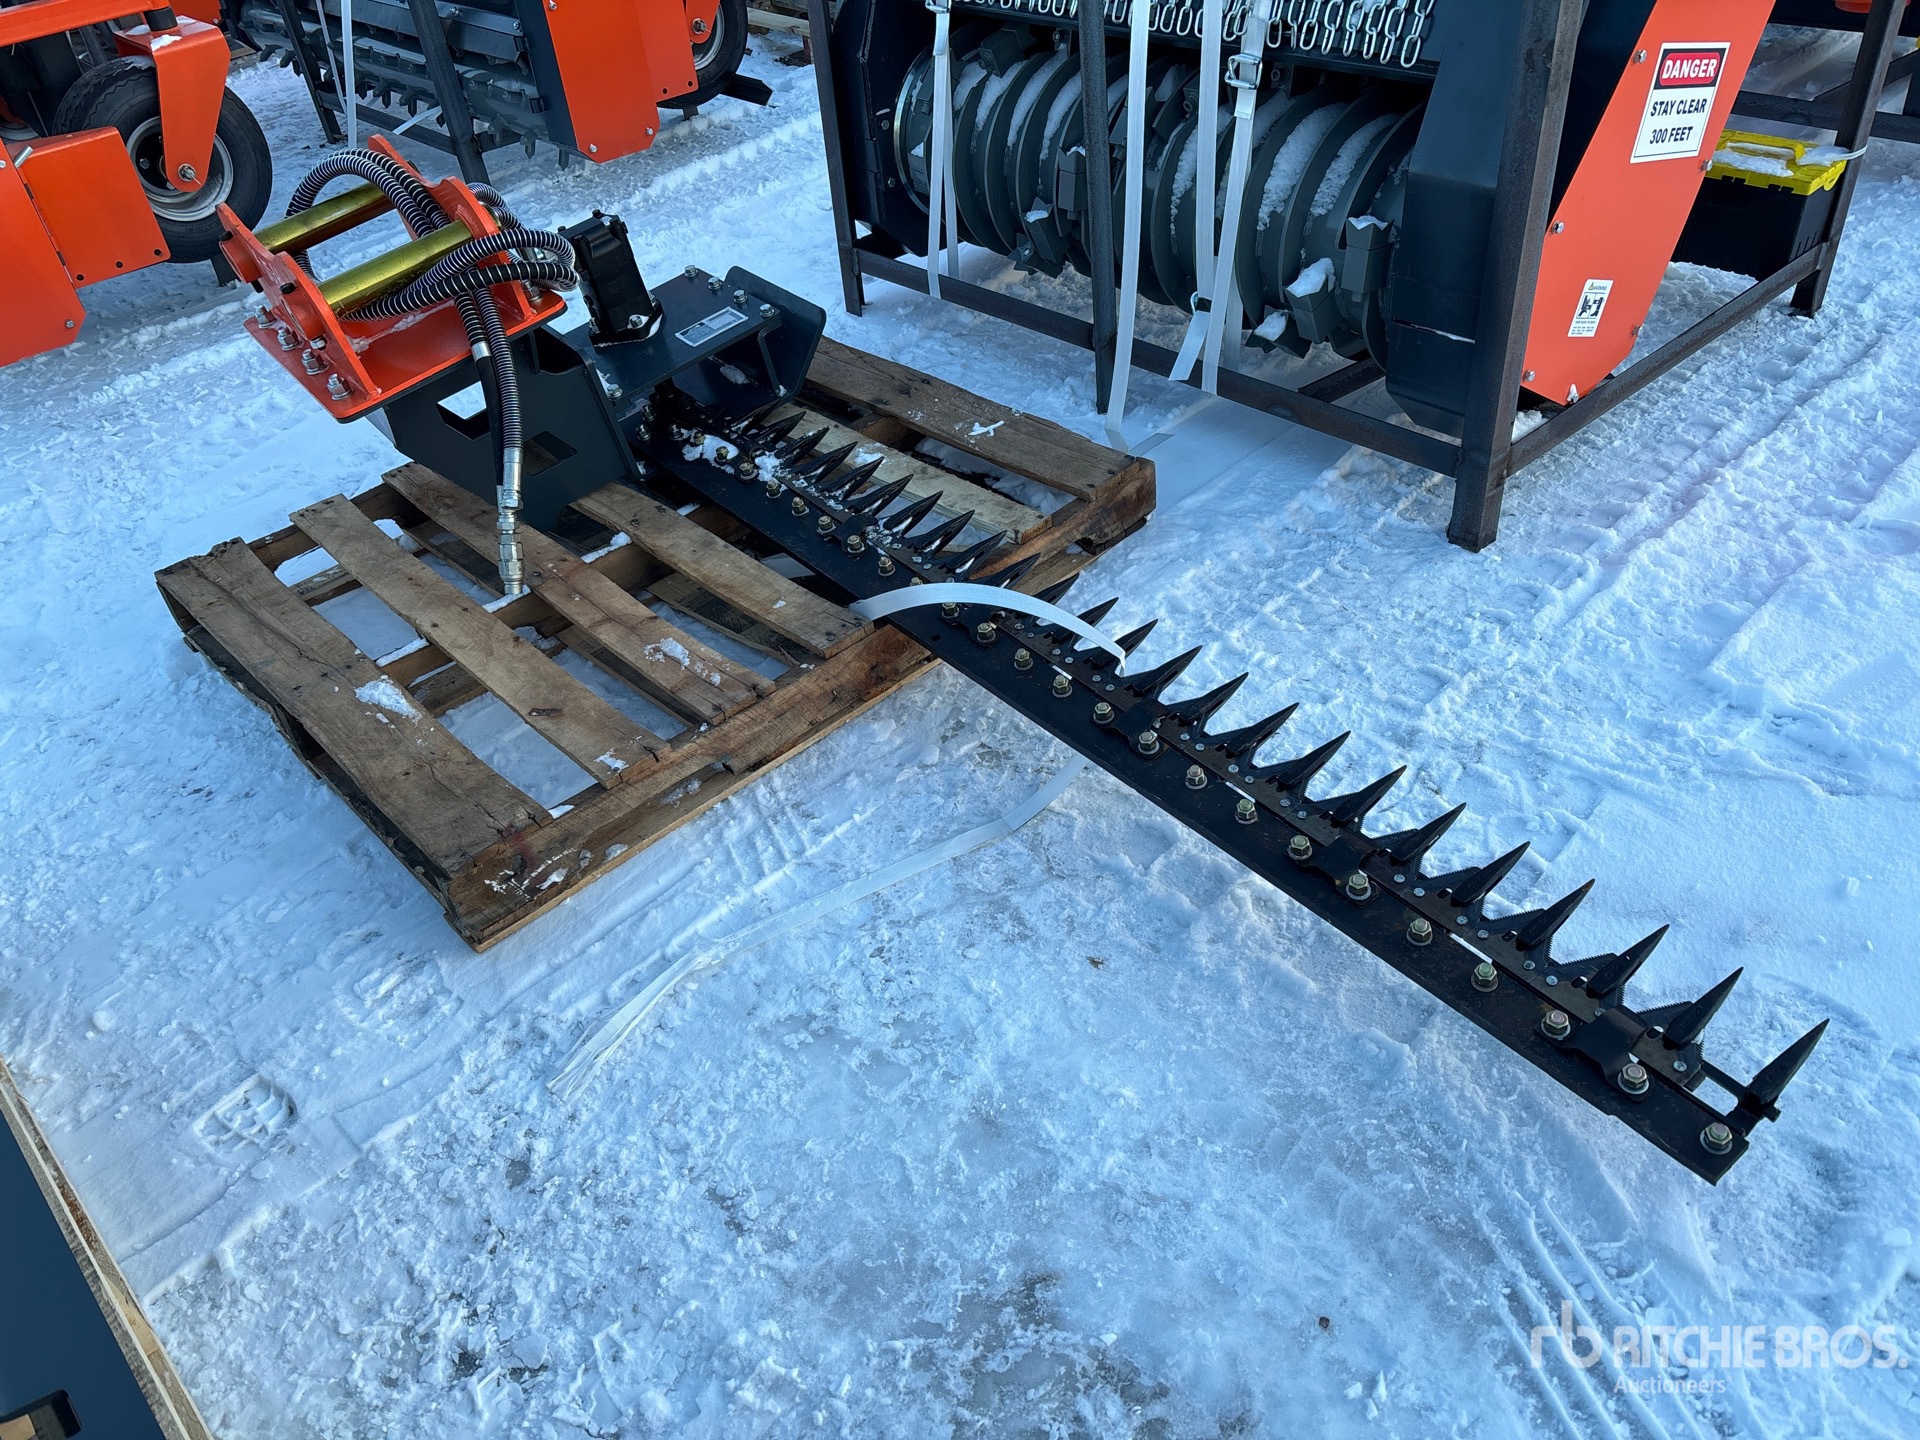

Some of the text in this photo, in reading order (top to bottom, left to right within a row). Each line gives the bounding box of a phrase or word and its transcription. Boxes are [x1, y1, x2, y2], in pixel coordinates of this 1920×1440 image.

[1662, 59, 1717, 78] DANGER
[1650, 99, 1707, 116] STAY CLEAR
[1649, 126, 1693, 144] 300 FEET
